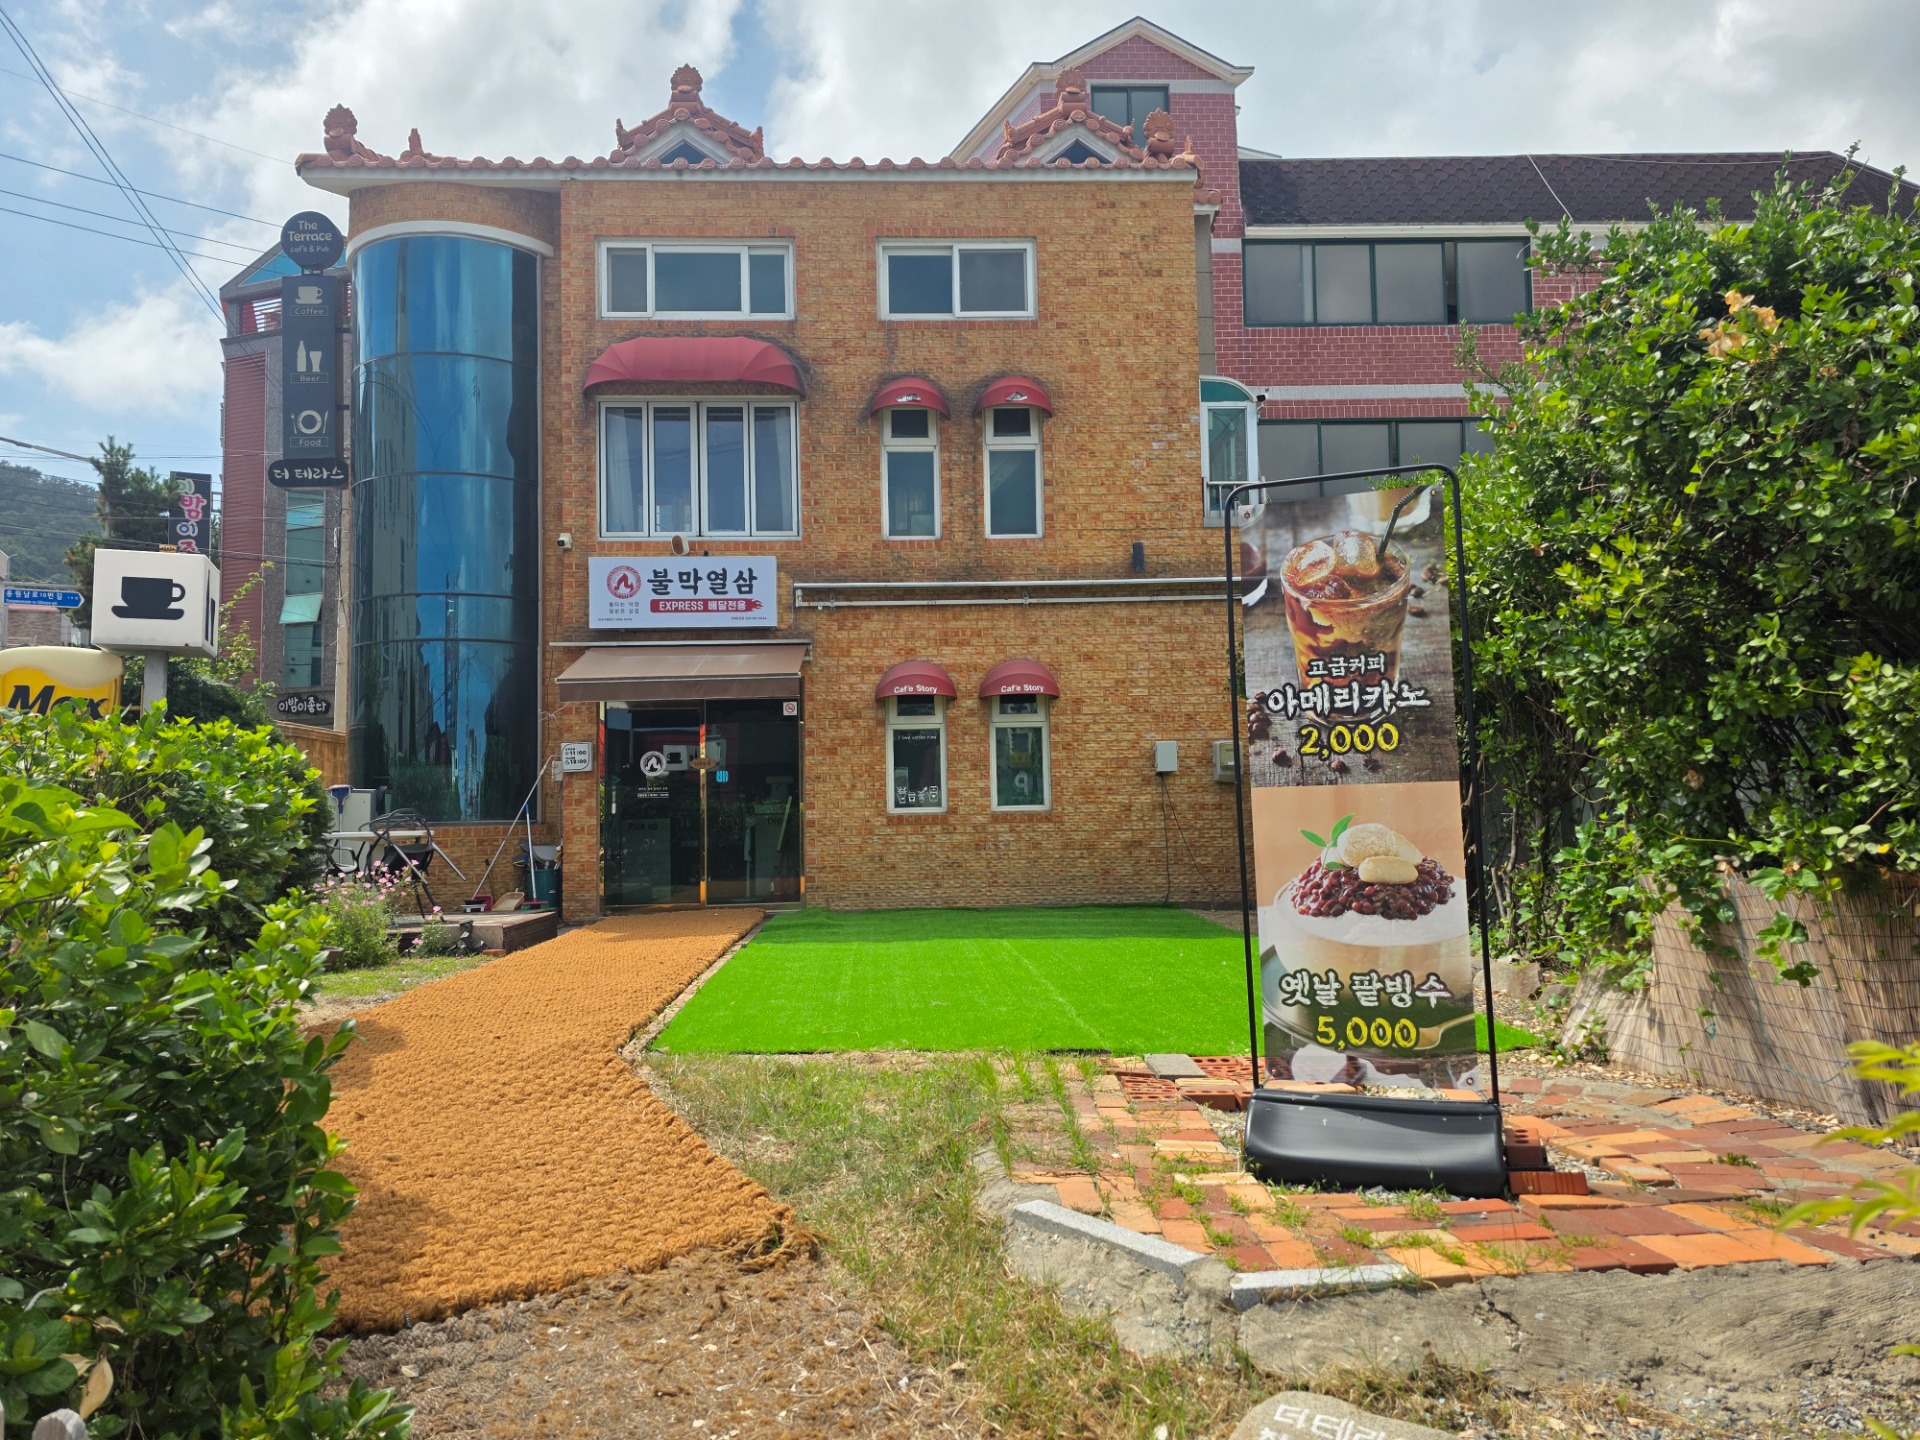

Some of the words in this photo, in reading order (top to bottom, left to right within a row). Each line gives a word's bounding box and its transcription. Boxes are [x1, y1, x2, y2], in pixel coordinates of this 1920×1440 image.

[297, 220, 318, 231] The
[287, 231, 333, 242] Terrace
[309, 245, 315, 253] &
[316, 245, 330, 253] Pub
[294, 307, 325, 315] Coffee
[299, 438, 321, 446] Food
[273, 467, 290, 480] 더
[293, 466, 345, 480] 테라스
[646, 567, 758, 596] 불막열삼
[658, 600, 704, 611] EXPRESS
[707, 600, 747, 611] 배달전용
[1307, 653, 1385, 677] 고급커피
[915, 684, 938, 694] Story
[1023, 683, 1045, 693] Story
[278, 696, 327, 713] 이밤이좋다
[1267, 679, 1431, 718] 아메리카노
[1300, 722, 1399, 760] 2,000
[1281, 970, 1342, 1007] 옛날
[1351, 971, 1452, 1009] 팥빙수
[1316, 1015, 1417, 1050] 5,000
